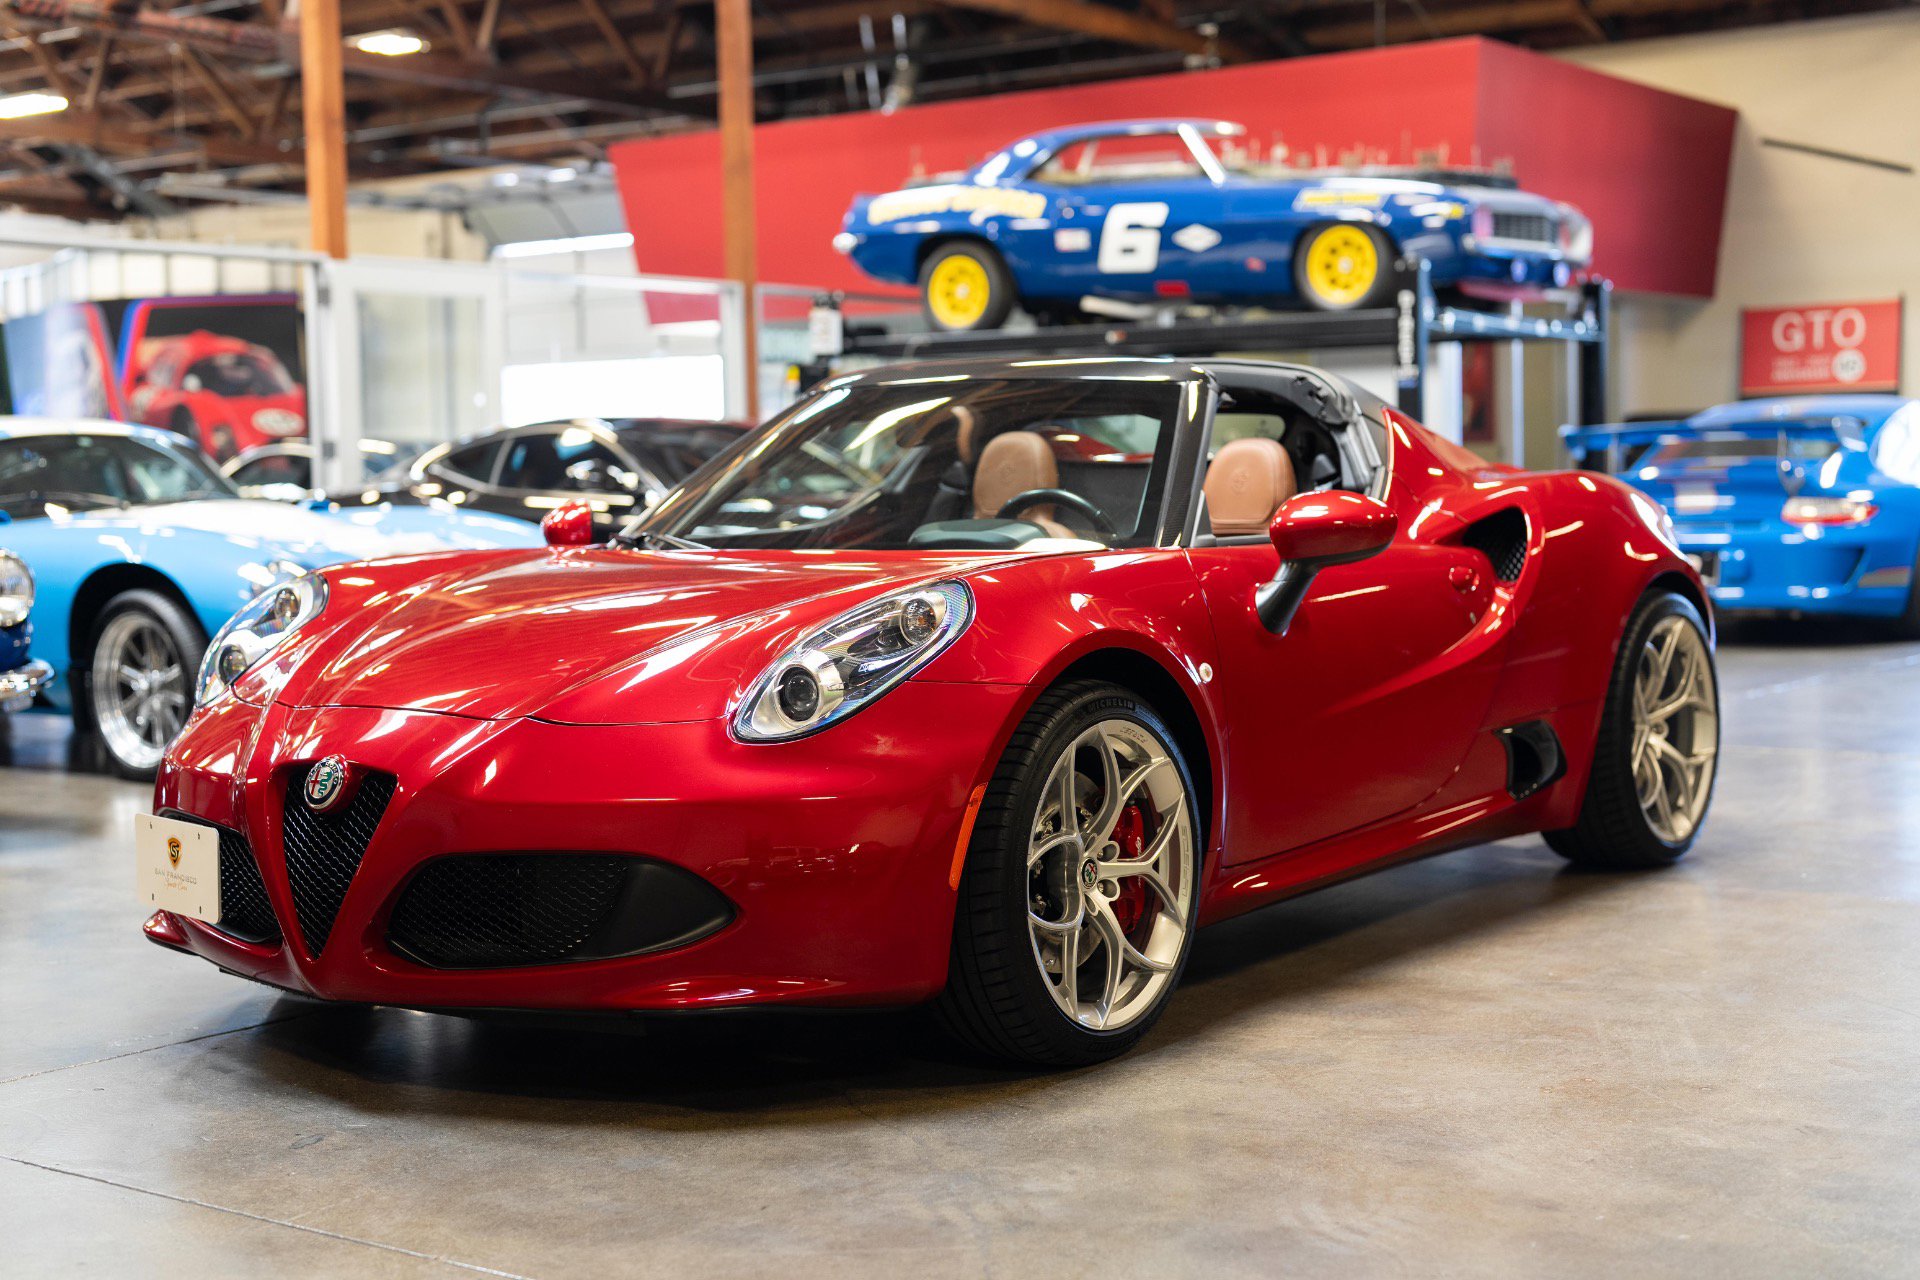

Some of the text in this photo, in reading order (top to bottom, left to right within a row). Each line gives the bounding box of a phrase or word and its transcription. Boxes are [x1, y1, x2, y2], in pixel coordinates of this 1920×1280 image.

[1097, 201, 1170, 274] 6
[1772, 307, 1867, 352] GTO
[1088, 697, 1134, 711] MICHELIN
